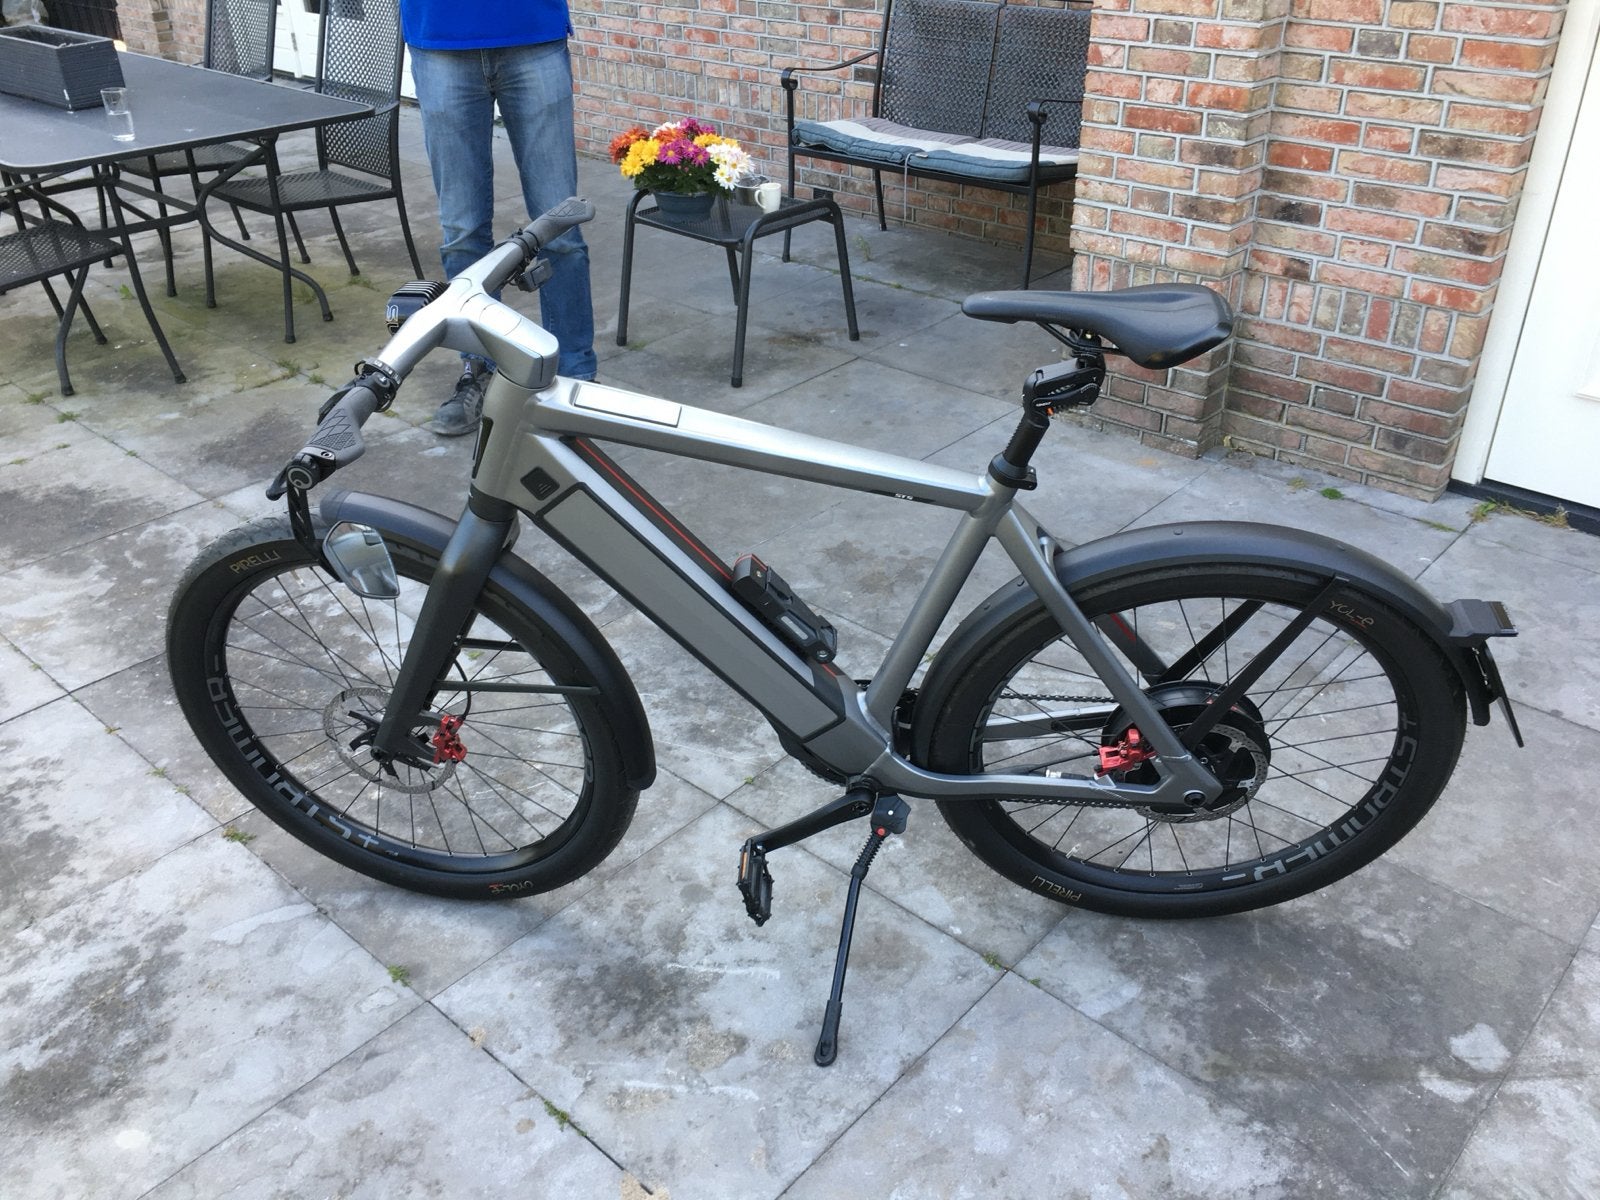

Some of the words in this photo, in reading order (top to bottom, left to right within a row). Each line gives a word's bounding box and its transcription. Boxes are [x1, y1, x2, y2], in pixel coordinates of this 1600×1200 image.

[229, 550, 282, 574] PIRELLI
[1329, 600, 1375, 626] YCL-e
[1031, 875, 1082, 902] PIRELLI
